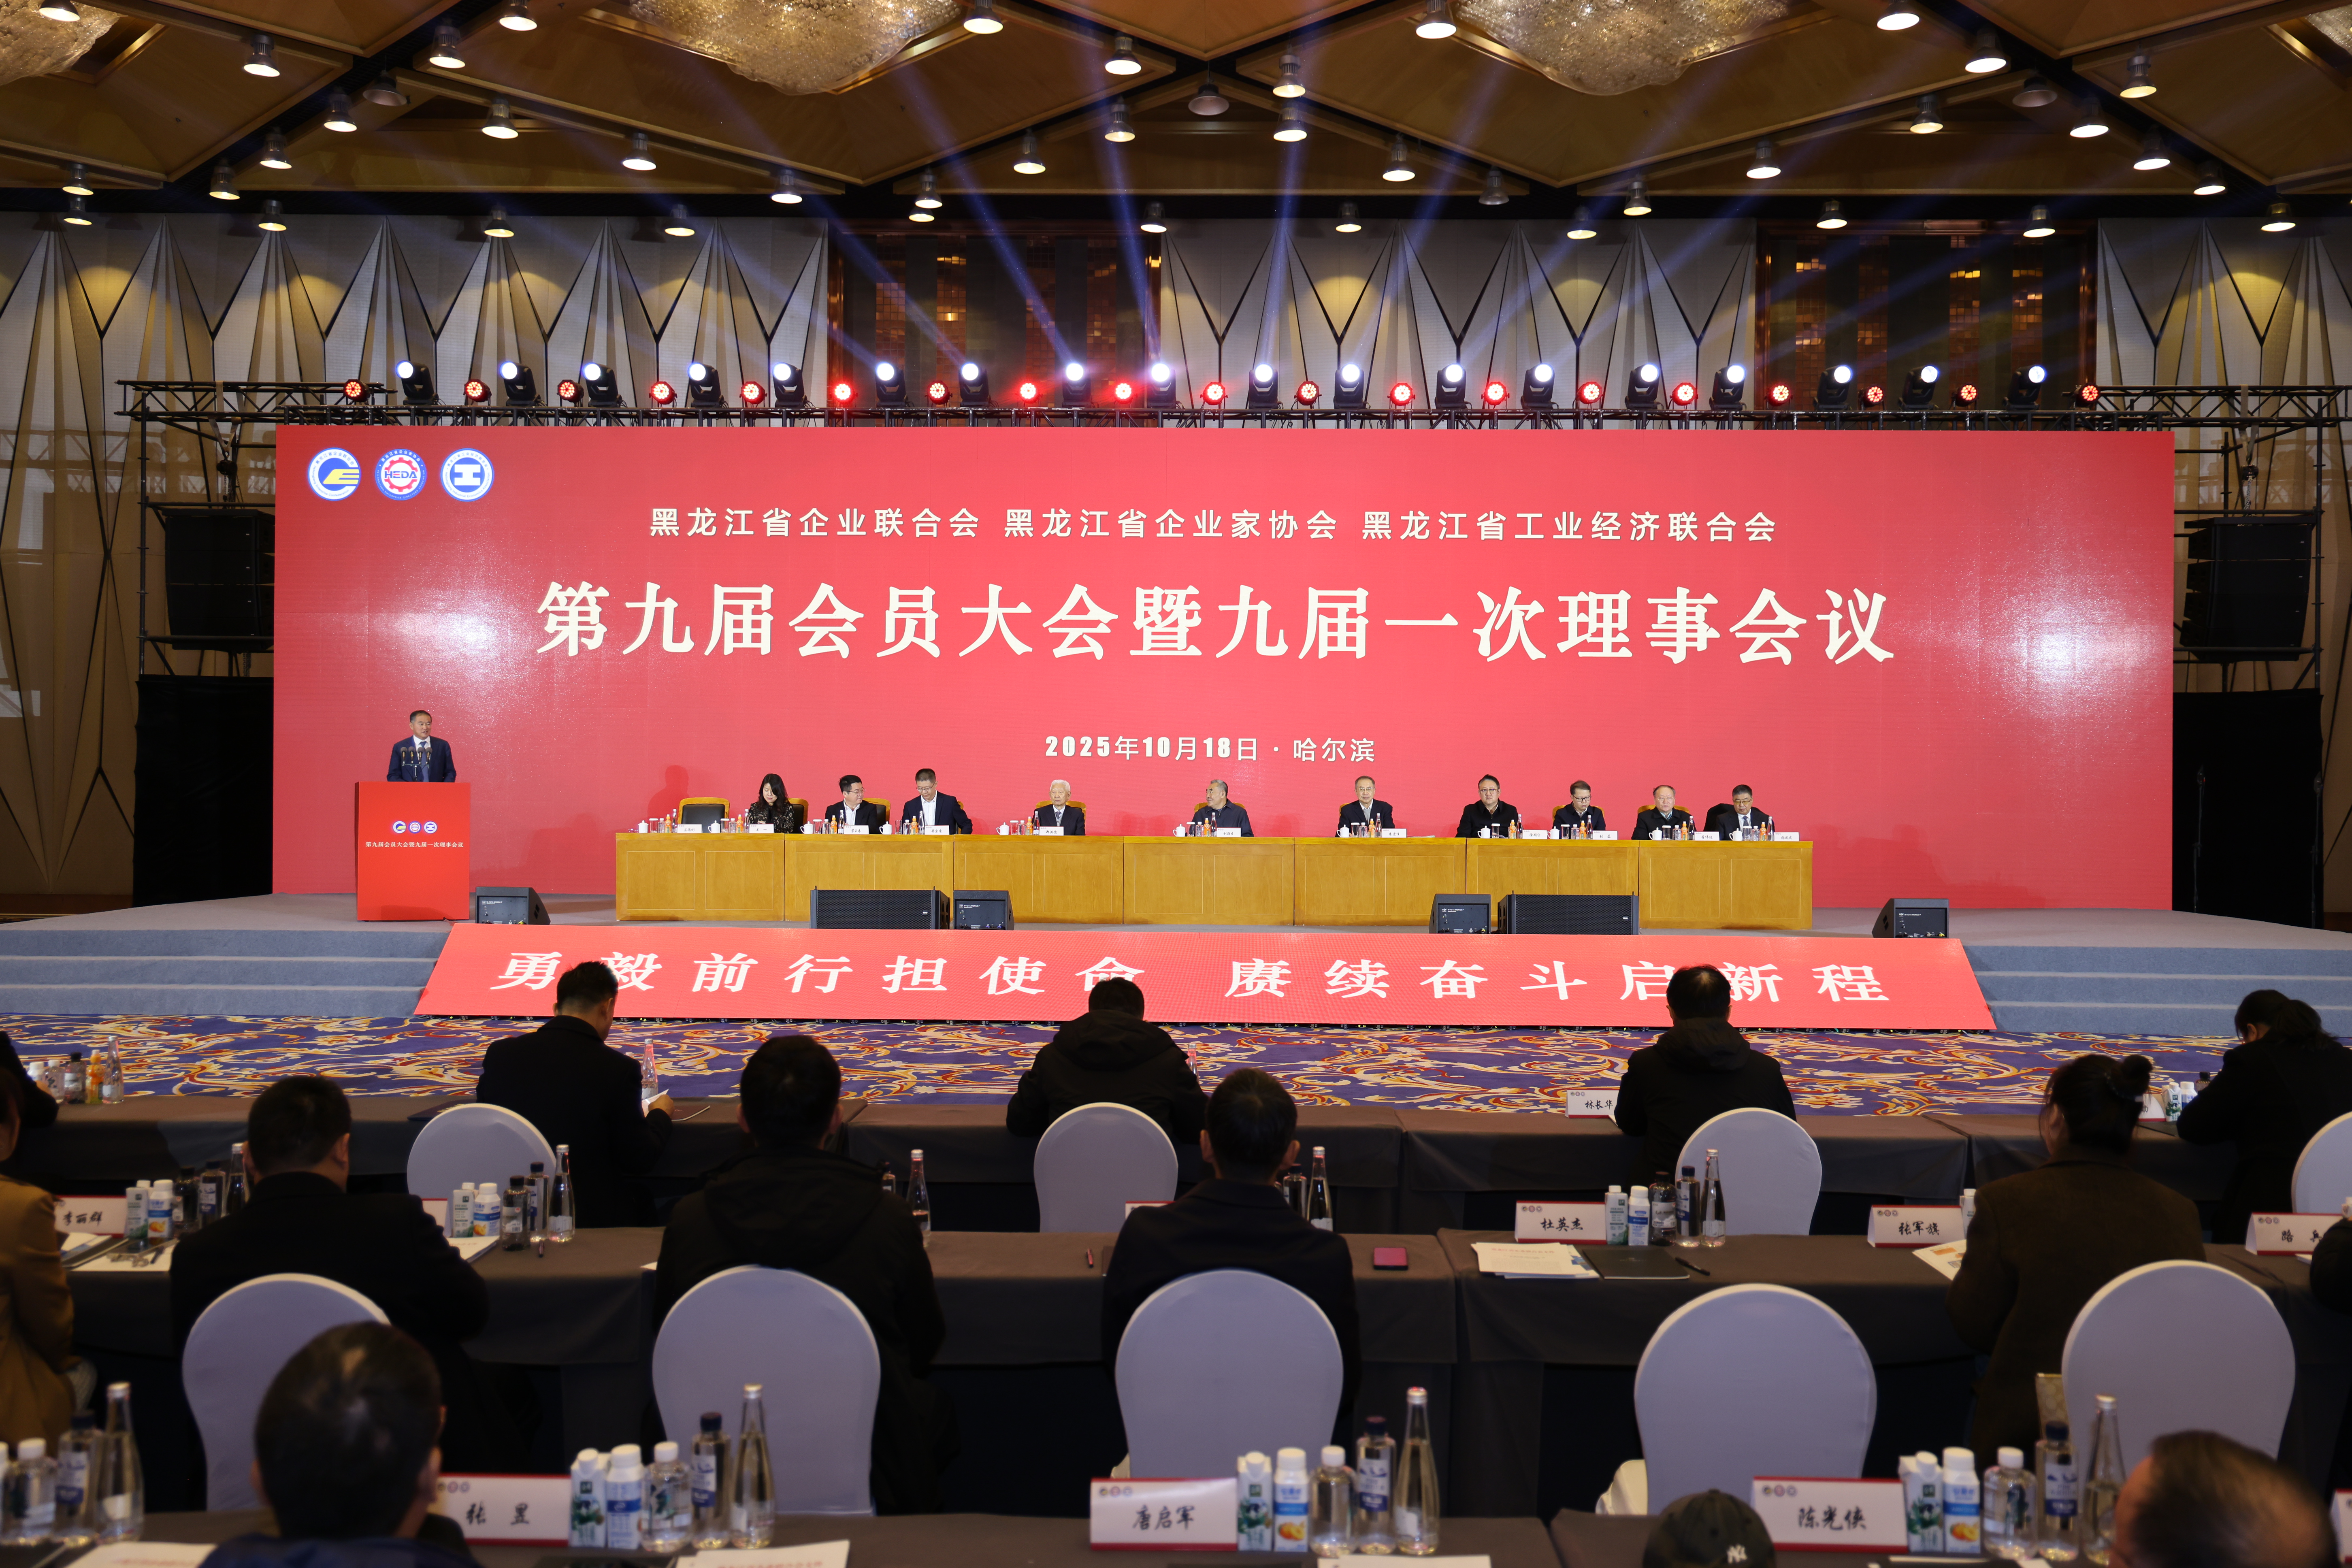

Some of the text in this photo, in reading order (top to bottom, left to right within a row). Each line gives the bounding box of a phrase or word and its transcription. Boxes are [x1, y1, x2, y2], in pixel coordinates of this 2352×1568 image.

[384, 471, 418, 479] HEDA
[650, 507, 1776, 541] 黑龙江省企业联合会 黑龙江省企业家协会 黑龙江省工业经济联合会
[537, 581, 1894, 665] 第九届会员大会暨九届一次理事会议
[490, 951, 1890, 1002] 勇毅前行担使命 赓续奋斗启新程
[1585, 1099, 1613, 1110] 林长华
[63, 1211, 102, 1226] 李丽群
[1540, 1216, 1583, 1232] 杜英杰
[1898, 1221, 1940, 1236] 张军旗
[1133, 1504, 1195, 1530] 唐启军
